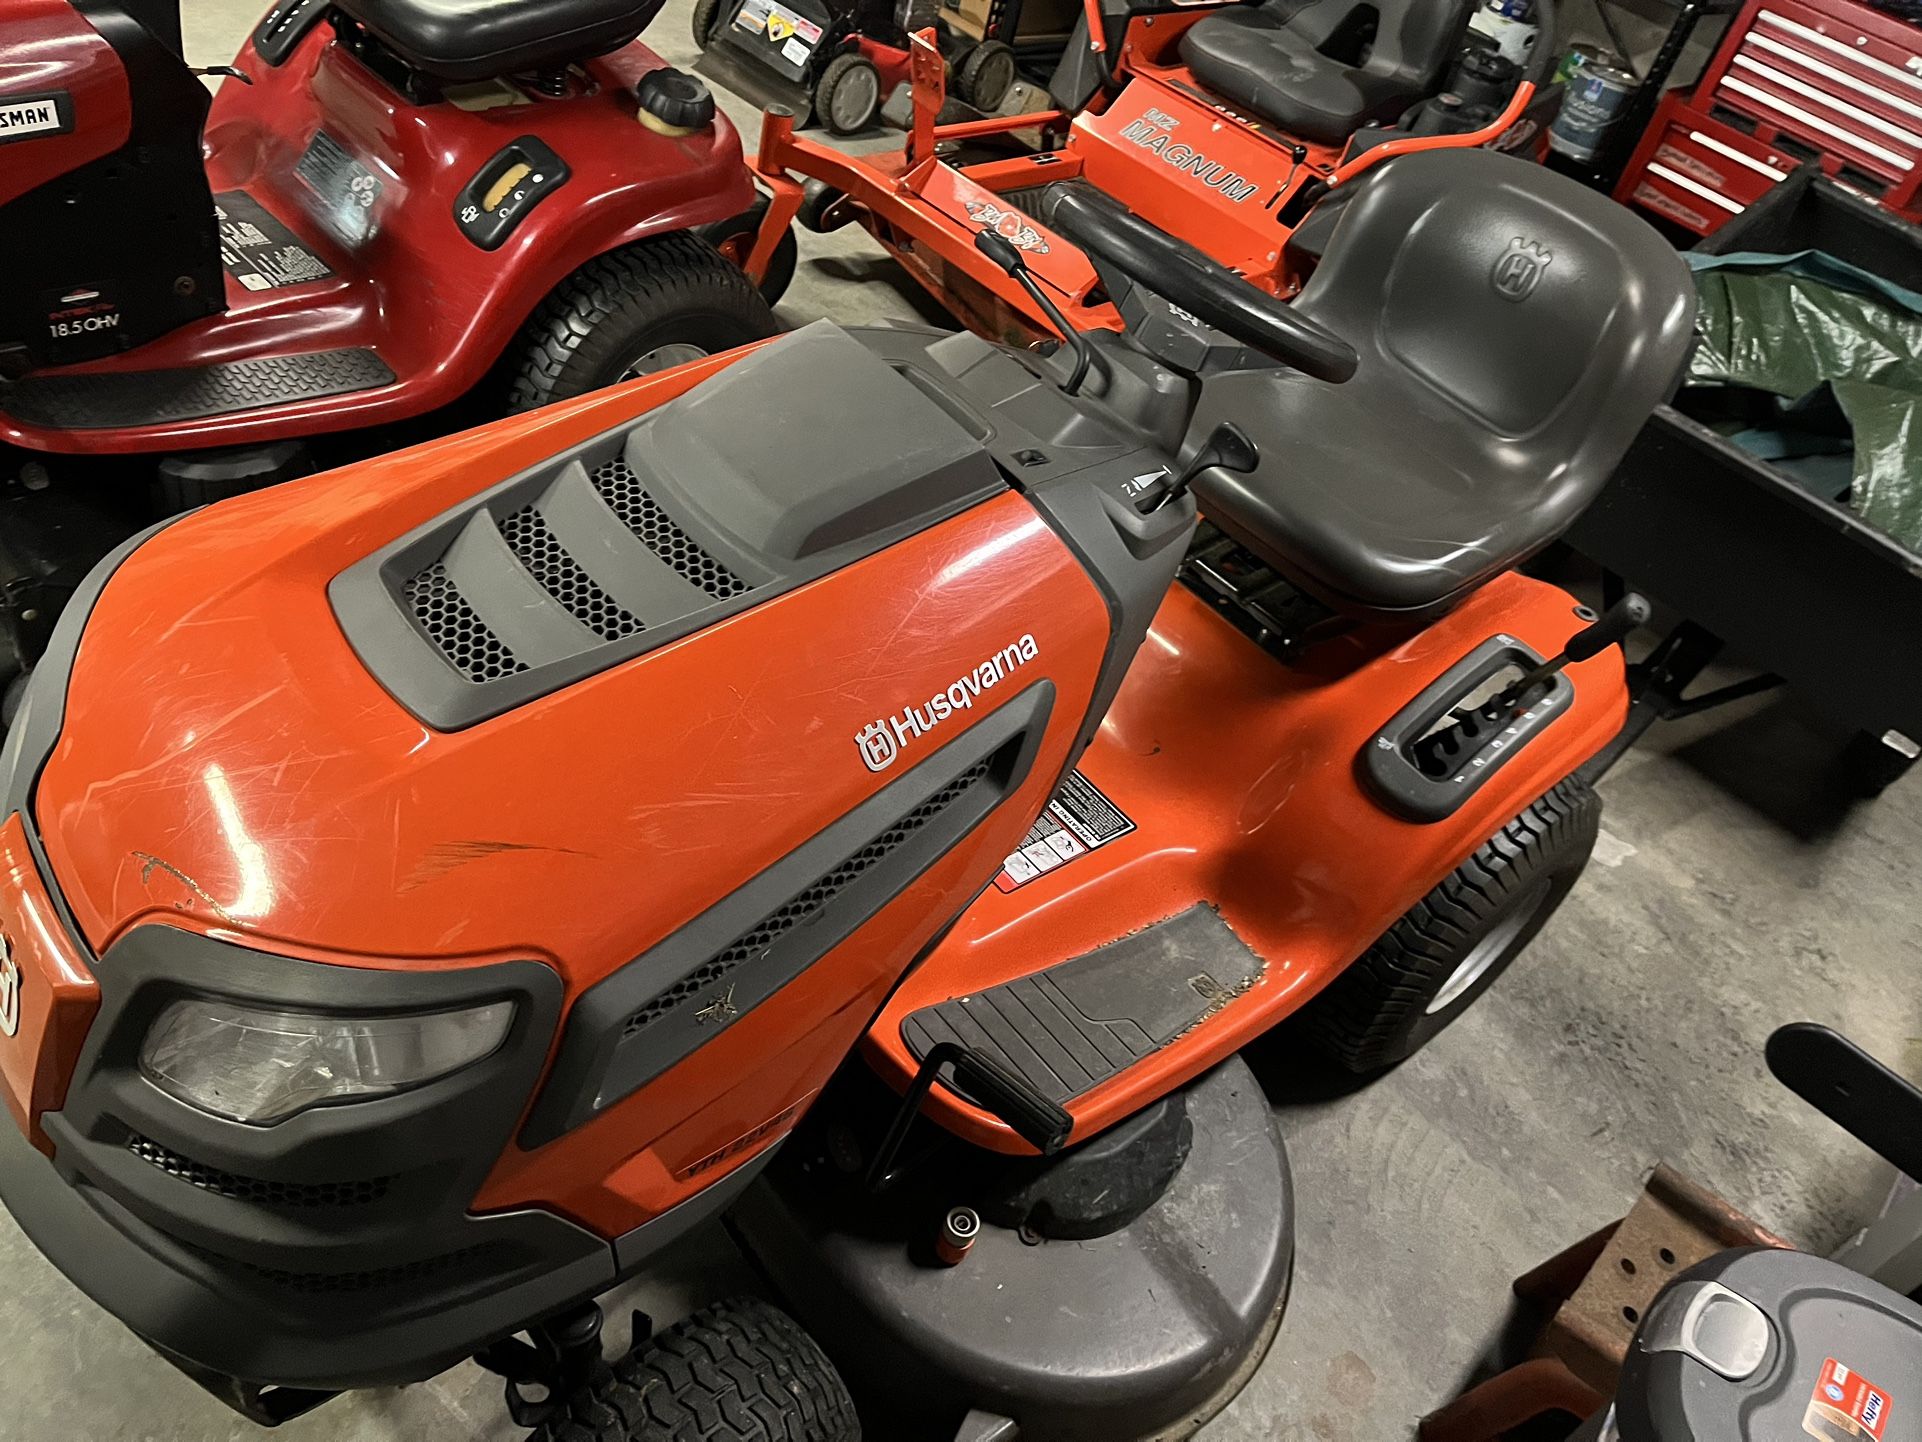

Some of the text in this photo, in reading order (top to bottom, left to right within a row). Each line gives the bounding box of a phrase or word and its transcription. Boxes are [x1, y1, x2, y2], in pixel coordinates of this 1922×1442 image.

[1143, 107, 1180, 132] MZ
[1118, 119, 1259, 203] MAGNUM
[889, 633, 1039, 748] Husqvarna
[1059, 809, 1092, 842] OPERATING
[1861, 1392, 1882, 1426] Hefty
